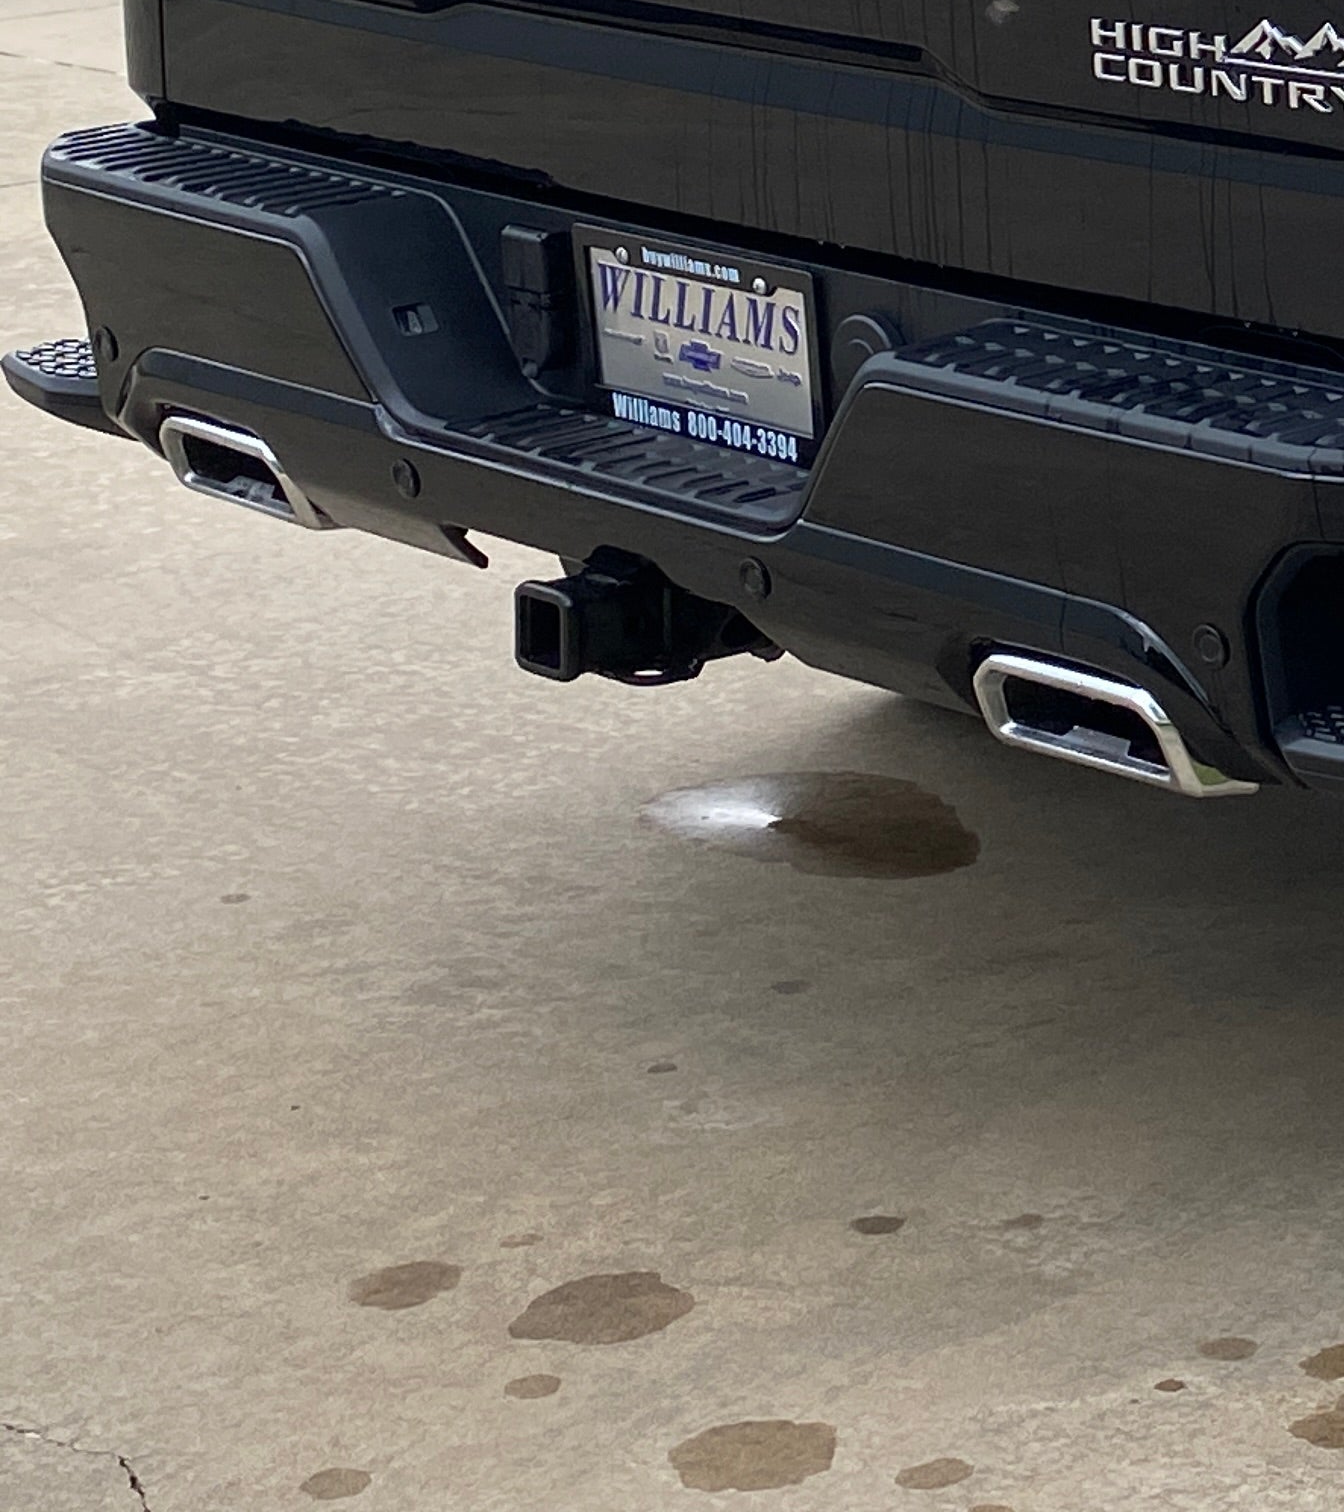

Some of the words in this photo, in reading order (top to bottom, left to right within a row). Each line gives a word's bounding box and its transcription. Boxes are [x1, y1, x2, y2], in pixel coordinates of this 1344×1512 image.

[1090, 17, 1227, 62] HIGH
[641, 245, 741, 284] buywilliams.com
[597, 261, 801, 356] WILLIAMS
[611, 391, 682, 433] Williams
[687, 411, 799, 463] 800-404-3394
